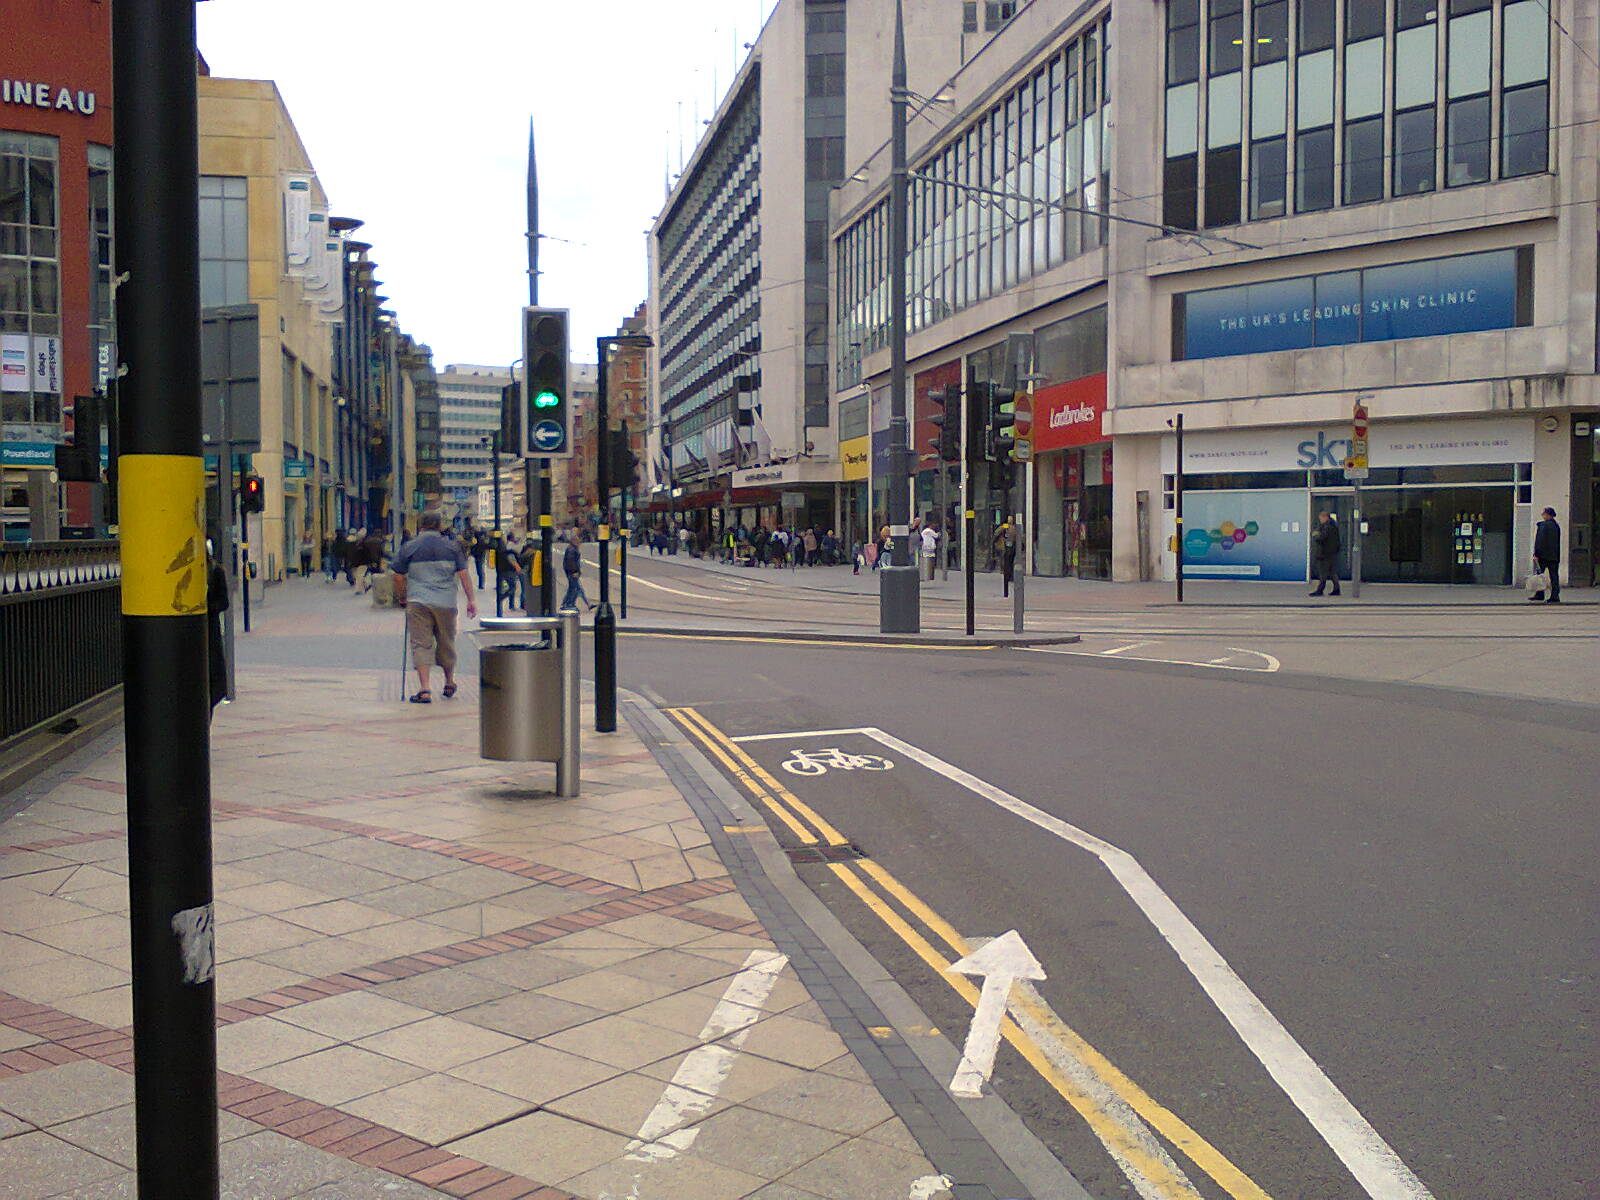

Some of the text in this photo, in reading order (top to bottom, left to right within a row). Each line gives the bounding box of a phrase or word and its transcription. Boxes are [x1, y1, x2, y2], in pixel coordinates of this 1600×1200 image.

[3, 79, 95, 115] INEAU
[1219, 289, 1477, 330] THE UK'S LEADING SKIN CLINIC
